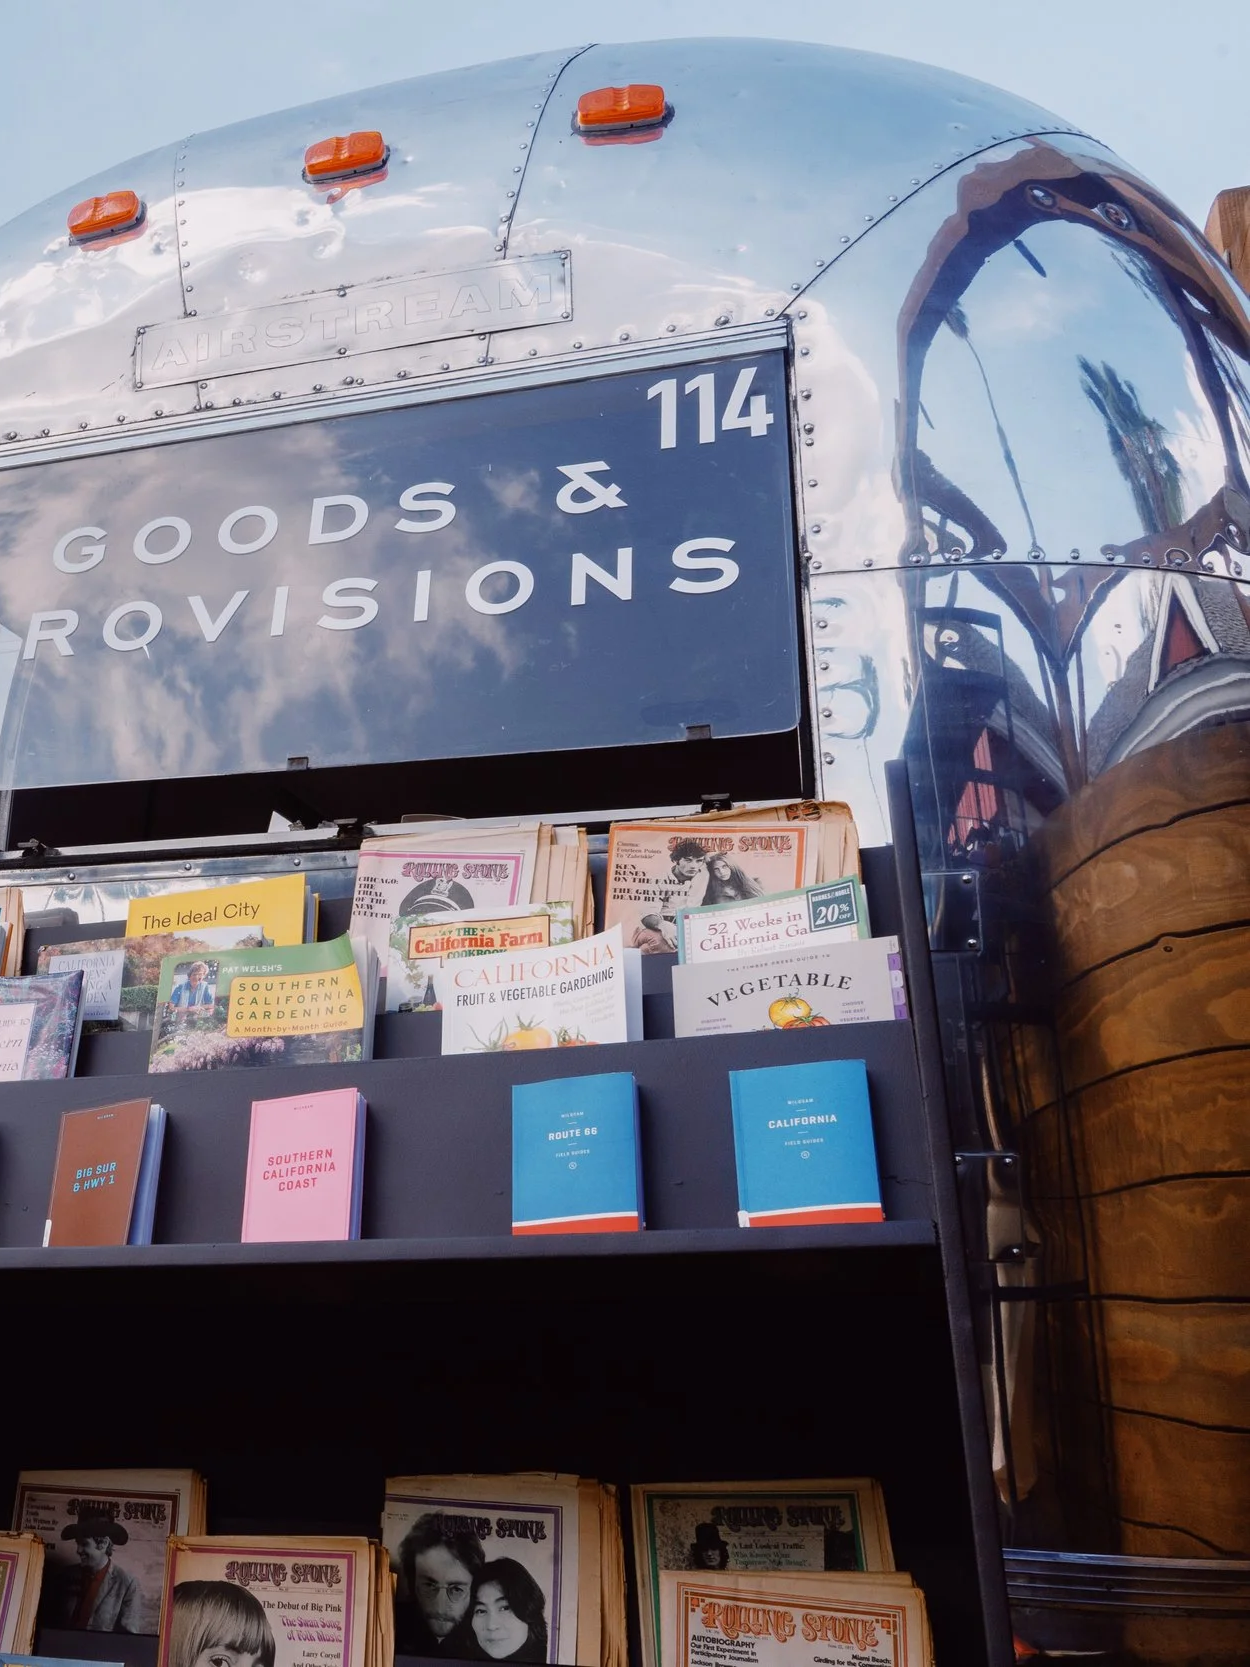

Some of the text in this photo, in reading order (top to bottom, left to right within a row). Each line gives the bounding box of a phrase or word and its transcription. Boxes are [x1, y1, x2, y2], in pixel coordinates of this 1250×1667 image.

[152, 270, 553, 371] AIRSTREAM
[648, 367, 774, 450] 114
[53, 461, 627, 573] GOODS &
[738, 836, 792, 854] STONE
[401, 862, 510, 882] ROLLING STONE
[358, 876, 399, 885] CHICAGO:
[357, 890, 385, 898] TRIAL
[635, 889, 690, 897] GRATEFUL
[353, 910, 393, 920] CULTURE
[354, 903, 374, 911] NEW
[142, 902, 260, 930] The Ideal City
[708, 911, 803, 936] 52 Weeks in
[456, 927, 478, 936] THE
[414, 930, 544, 955] California Farm
[700, 931, 780, 952] California
[454, 943, 615, 988] CALIFORNIA
[796, 955, 818, 963] GUIDE
[222, 964, 282, 974] PAT WELSH'S
[238, 976, 339, 992] SOUTHERN
[456, 967, 614, 1007] FRUIT & VEGETABLE GARDENING
[707, 972, 852, 1008] VEGETABLE
[237, 989, 354, 1006] CALIFORNIA
[235, 1004, 347, 1020] GARDENING
[19, 1018, 31, 1026] TO
[244, 1023, 321, 1034] Month-by-Month
[323, 1020, 348, 1028] Guide
[768, 1114, 837, 1129] CALIFORNIA
[548, 1127, 598, 1141] ROUTE 66
[268, 1148, 333, 1167] SOUTHERN
[76, 1162, 117, 1179] BIG SUR
[263, 1161, 336, 1181] CALIFORNIA
[73, 1175, 115, 1192] & HWY 1
[278, 1177, 317, 1192] COAST
[124, 1502, 166, 1524] STONE
[710, 1506, 783, 1532] ROLLING
[496, 1517, 547, 1543] STONE
[225, 1560, 342, 1588] ROLLING STONE
[262, 1600, 342, 1613] The Debut of Big Pink
[702, 1601, 879, 1651] ROLLING STONE
[691, 1634, 756, 1649] AUTOBIOGRAPHY
[302, 1650, 341, 1660] Larry Coryell
[690, 1649, 759, 1664] Participatory Journalism
[716, 1646, 750, 1656] Experiment
[852, 1654, 870, 1662] Miami
[690, 1659, 713, 1667] Jackson
[813, 1656, 835, 1666] Girding
